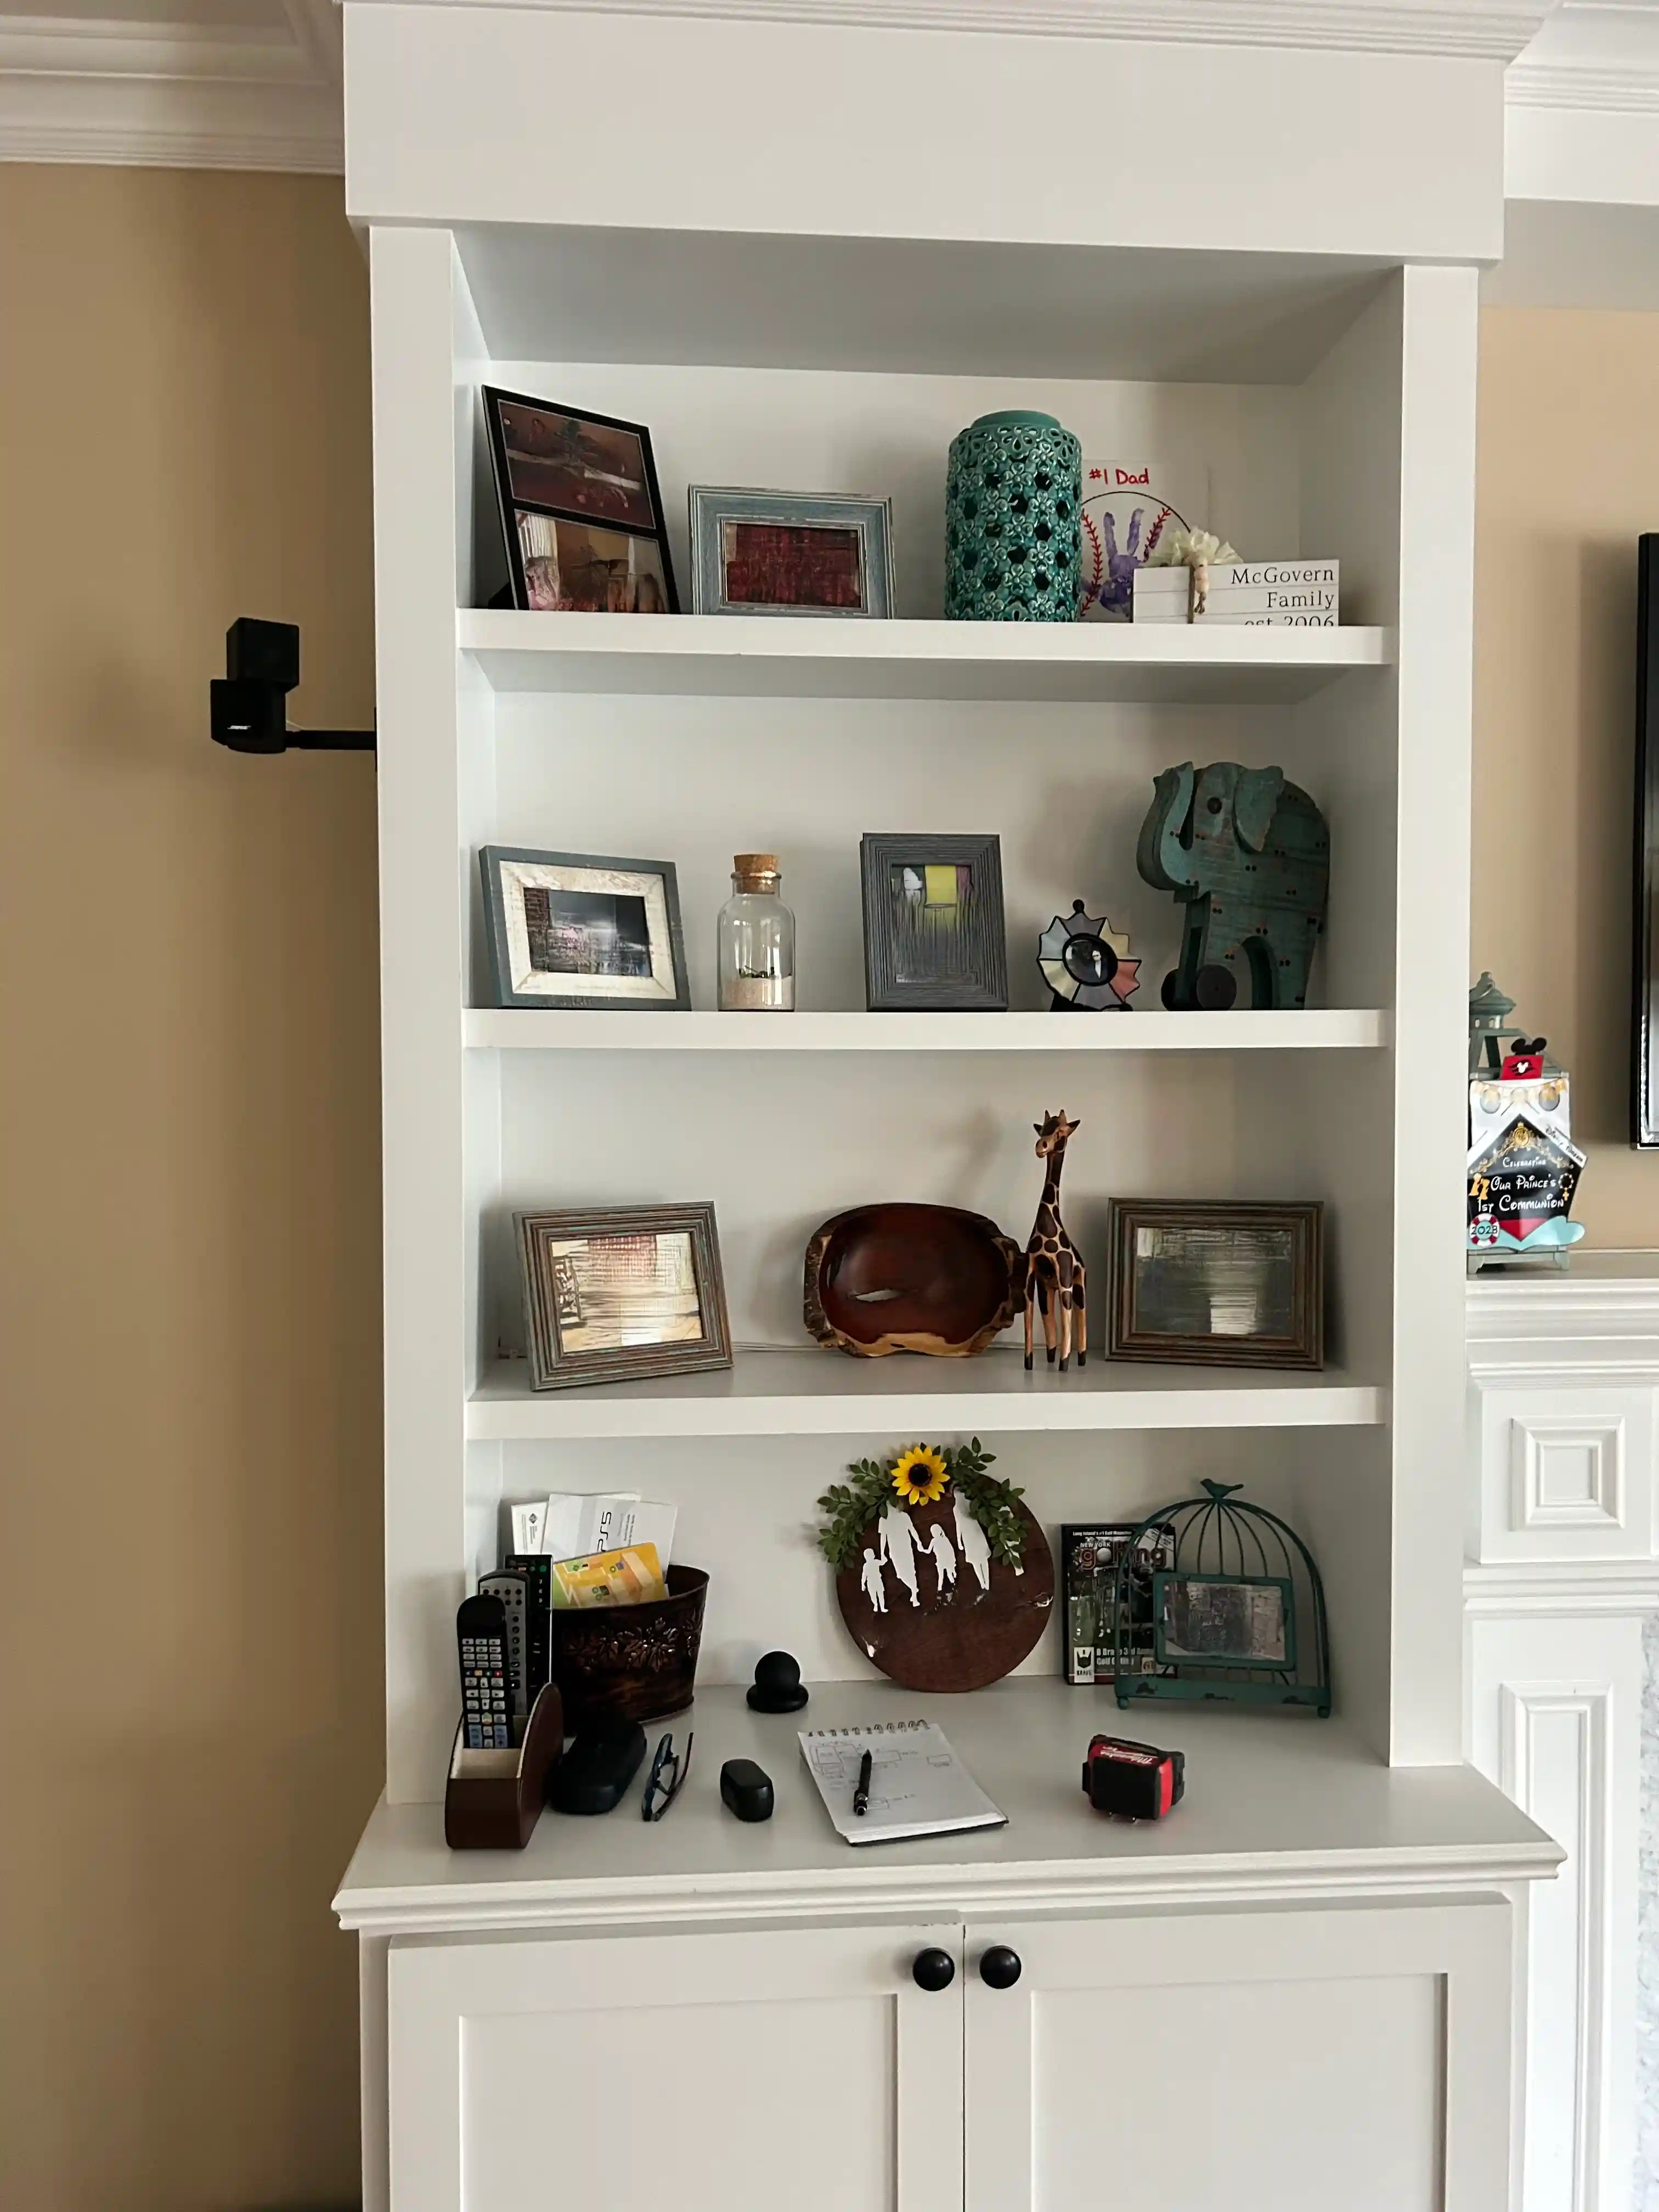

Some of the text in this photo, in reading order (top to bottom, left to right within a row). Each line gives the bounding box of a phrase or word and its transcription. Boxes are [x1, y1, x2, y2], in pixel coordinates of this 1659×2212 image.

[1088, 467, 1149, 485] #1 Dad
[1231, 567, 1334, 584] McGovern
[1267, 590, 1335, 610] Family
[1491, 1176, 1511, 1191] Our
[1499, 1193, 1564, 1211] Communion
